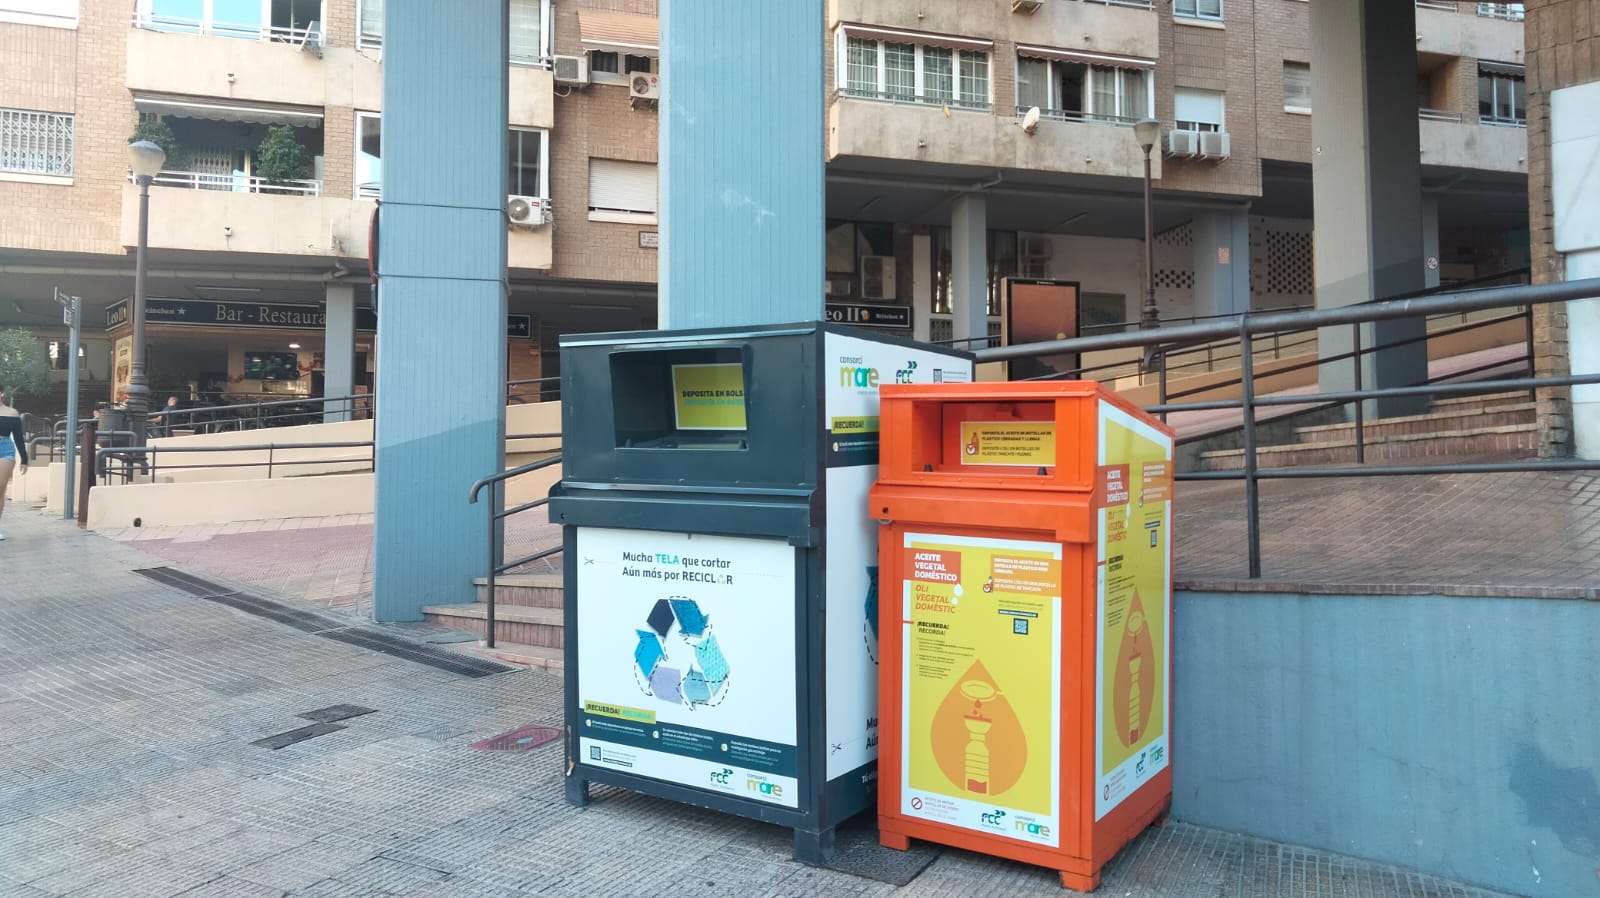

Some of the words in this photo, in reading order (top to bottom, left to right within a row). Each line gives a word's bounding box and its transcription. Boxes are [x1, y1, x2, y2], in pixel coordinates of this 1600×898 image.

[216, 304, 244, 321] Bar
[258, 306, 327, 325] Restaura
[839, 356, 863, 365] consorci
[840, 366, 880, 388] mare
[682, 390, 714, 398] DEPOSITA
[622, 551, 653, 563] Mucha
[655, 553, 680, 565] TELA
[681, 557, 699, 568] que
[701, 557, 731, 569] cortar
[914, 552, 942, 562] ACEITE
[914, 561, 947, 571] VEGETAL
[622, 566, 640, 577] Aún
[642, 567, 662, 579] más
[664, 571, 680, 582] por
[914, 570, 958, 582] DOMÉSTICO
[915, 584, 929, 593] OLI
[915, 593, 950, 604] VEGETAL
[915, 602, 957, 614] DOMÉSTIC
[585, 702, 621, 716] ¡RECUERDA!
[747, 779, 783, 798] mare
[1015, 820, 1050, 837] mare
